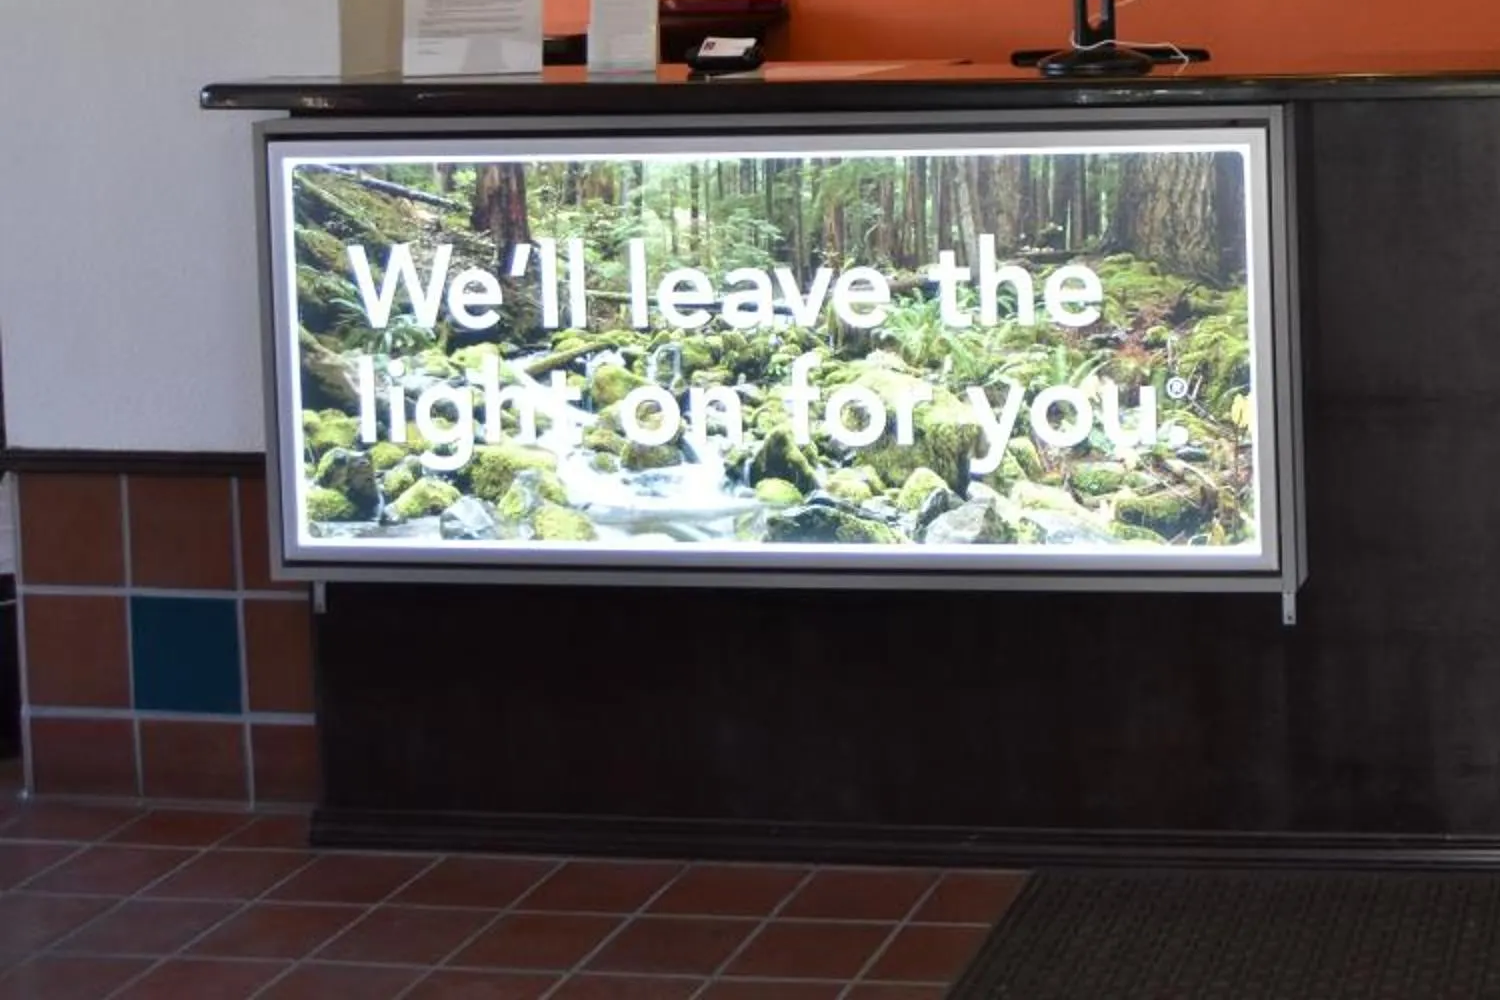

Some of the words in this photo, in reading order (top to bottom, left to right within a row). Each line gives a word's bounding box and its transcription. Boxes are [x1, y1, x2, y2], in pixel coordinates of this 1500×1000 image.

[346, 237, 588, 330] We'll
[629, 237, 891, 330] leave
[930, 233, 1102, 328] the
[358, 354, 582, 471] light
[620, 383, 744, 446] on
[783, 350, 933, 447] for
